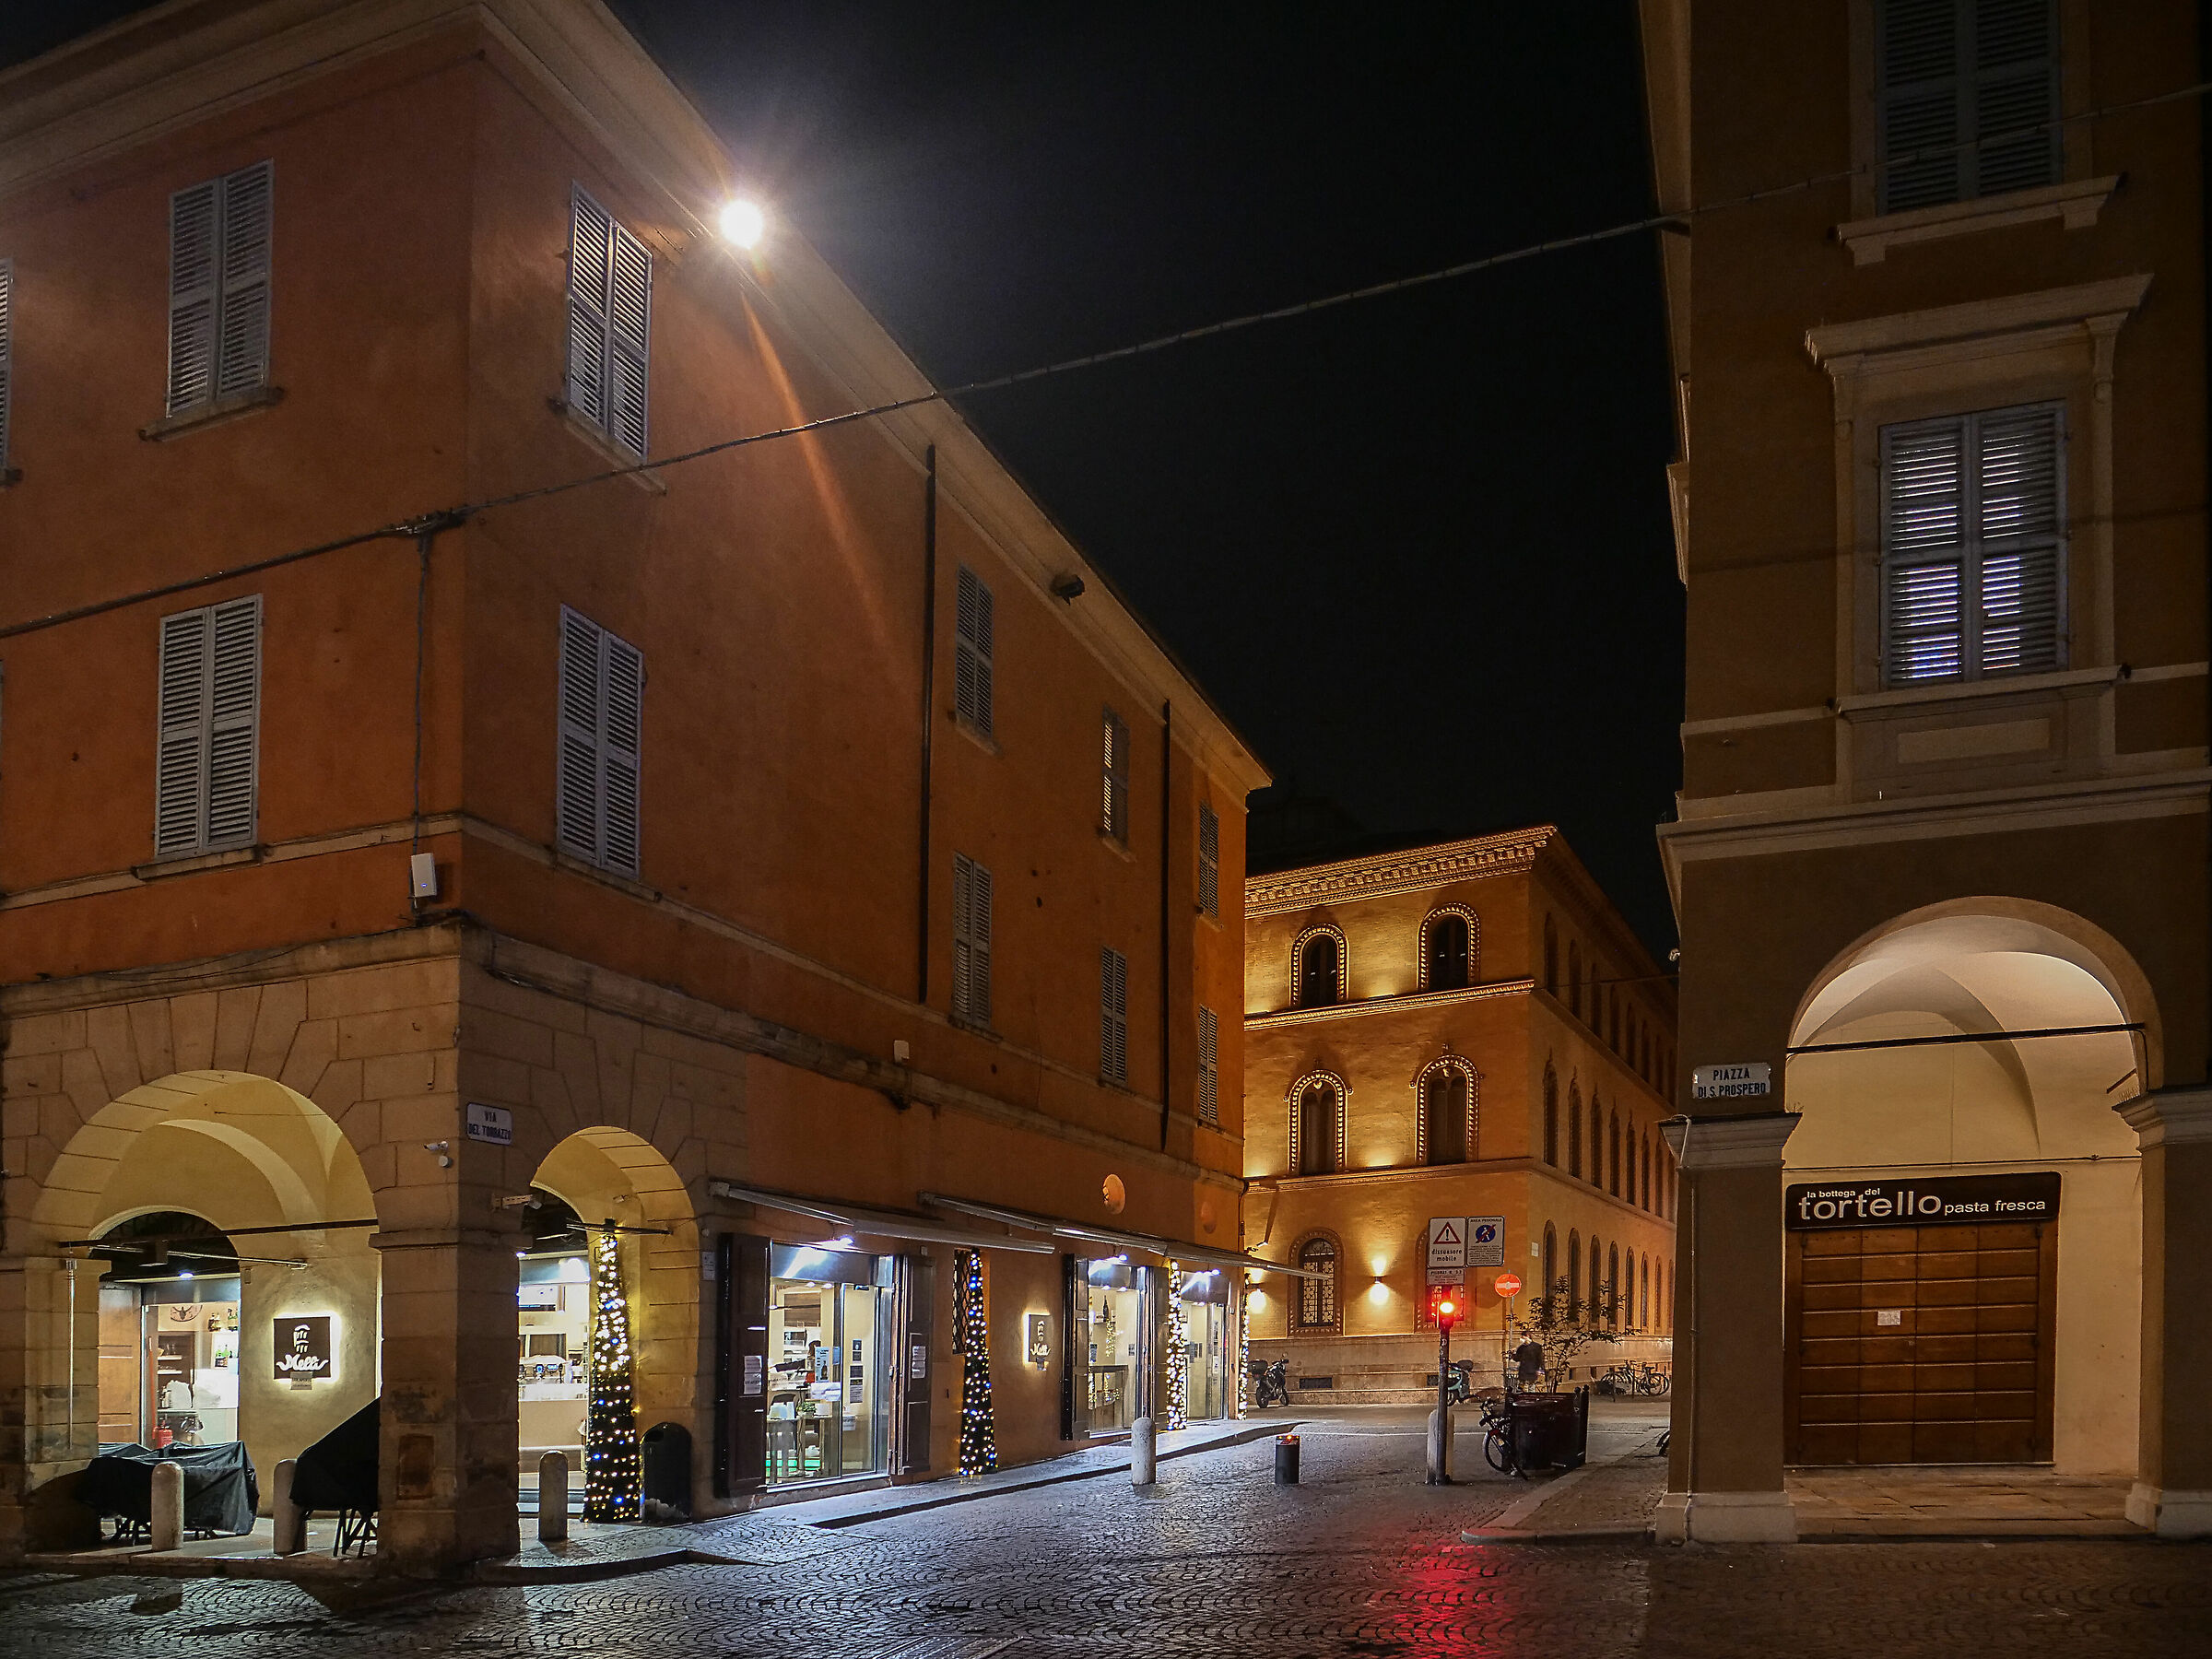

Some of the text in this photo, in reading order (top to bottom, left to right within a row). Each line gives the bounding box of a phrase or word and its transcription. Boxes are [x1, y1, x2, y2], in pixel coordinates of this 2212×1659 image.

[1713, 1068, 1750, 1080] PIAZZA
[1698, 1087, 1707, 1098] DI
[1719, 1083, 1766, 1097] PROSPERO
[484, 1111, 497, 1123] VIA
[1819, 1190, 1856, 1198] bottega
[1798, 1191, 2046, 1220] tortello pasta fresca
